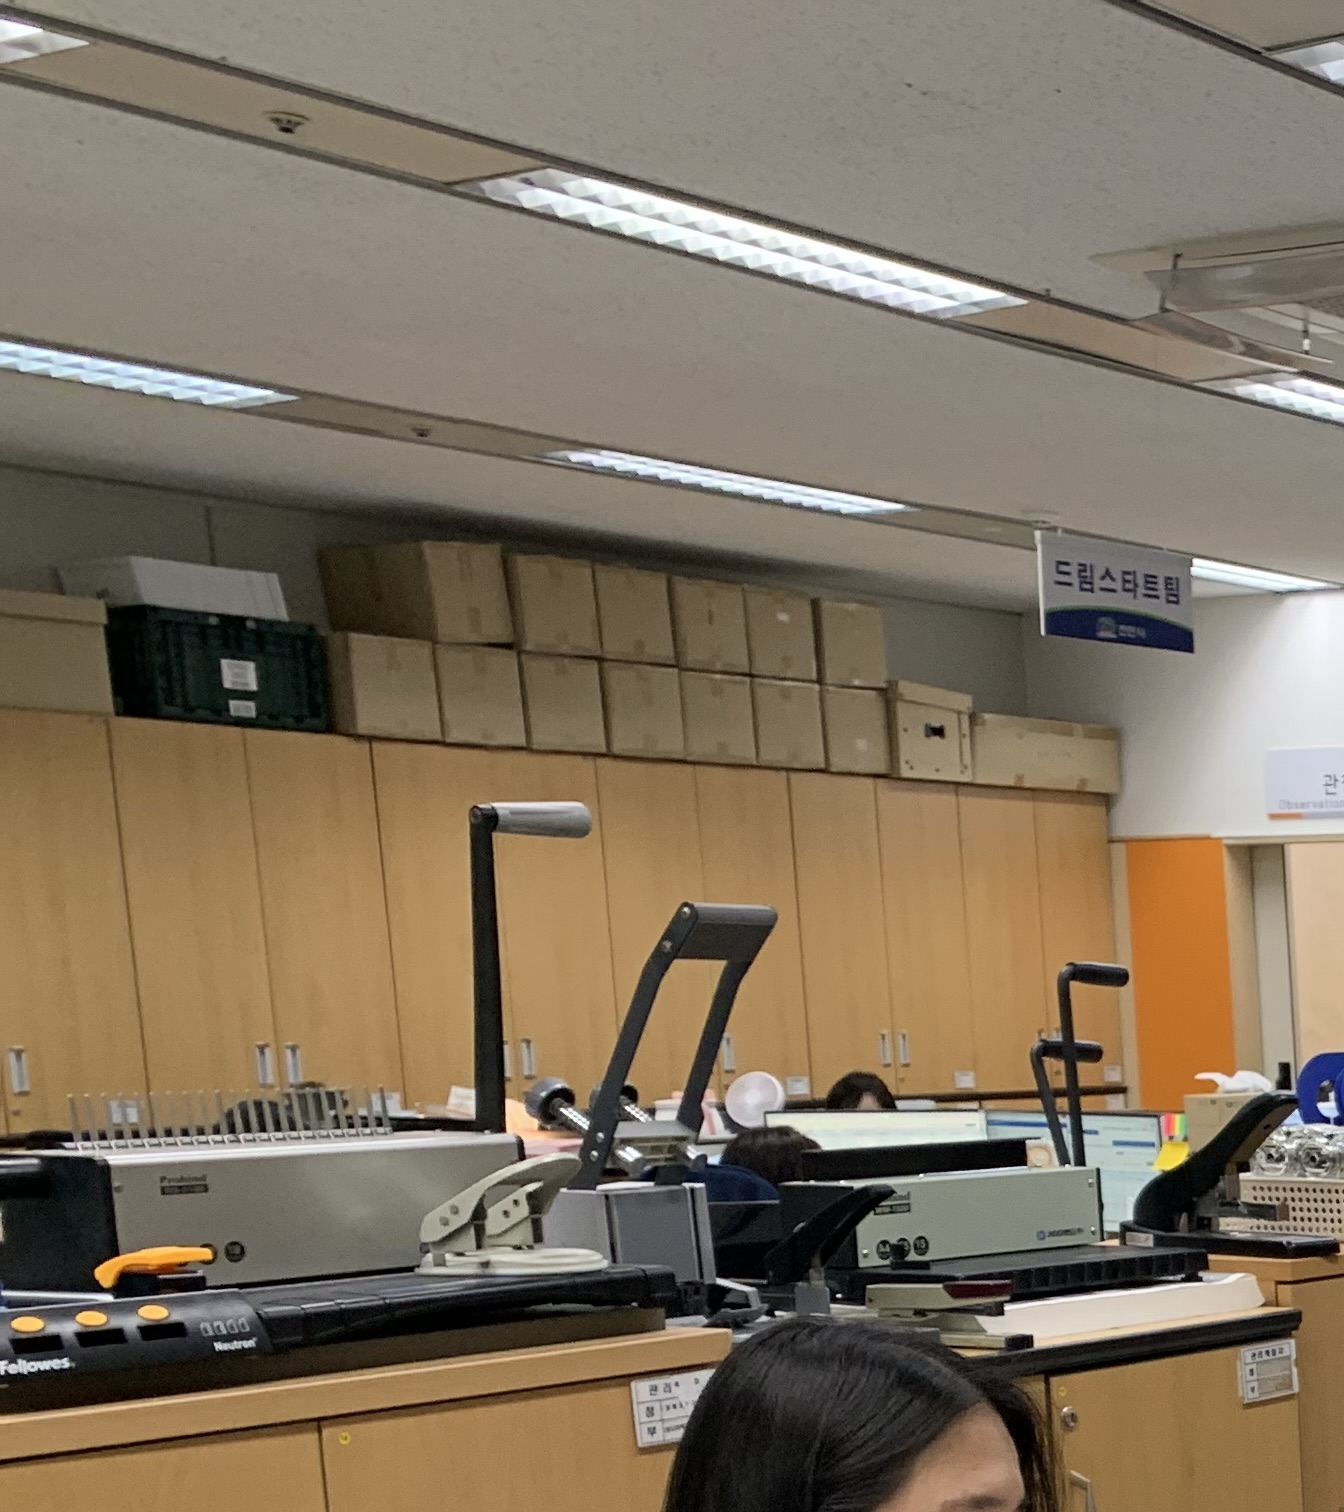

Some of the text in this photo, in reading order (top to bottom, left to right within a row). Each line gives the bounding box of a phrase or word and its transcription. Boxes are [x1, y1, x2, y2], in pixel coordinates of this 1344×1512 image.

[1053, 559, 1180, 605] 드림스타트팀
[213, 1338, 255, 1352] Neutron
[0, 1357, 70, 1376] Fellowes
